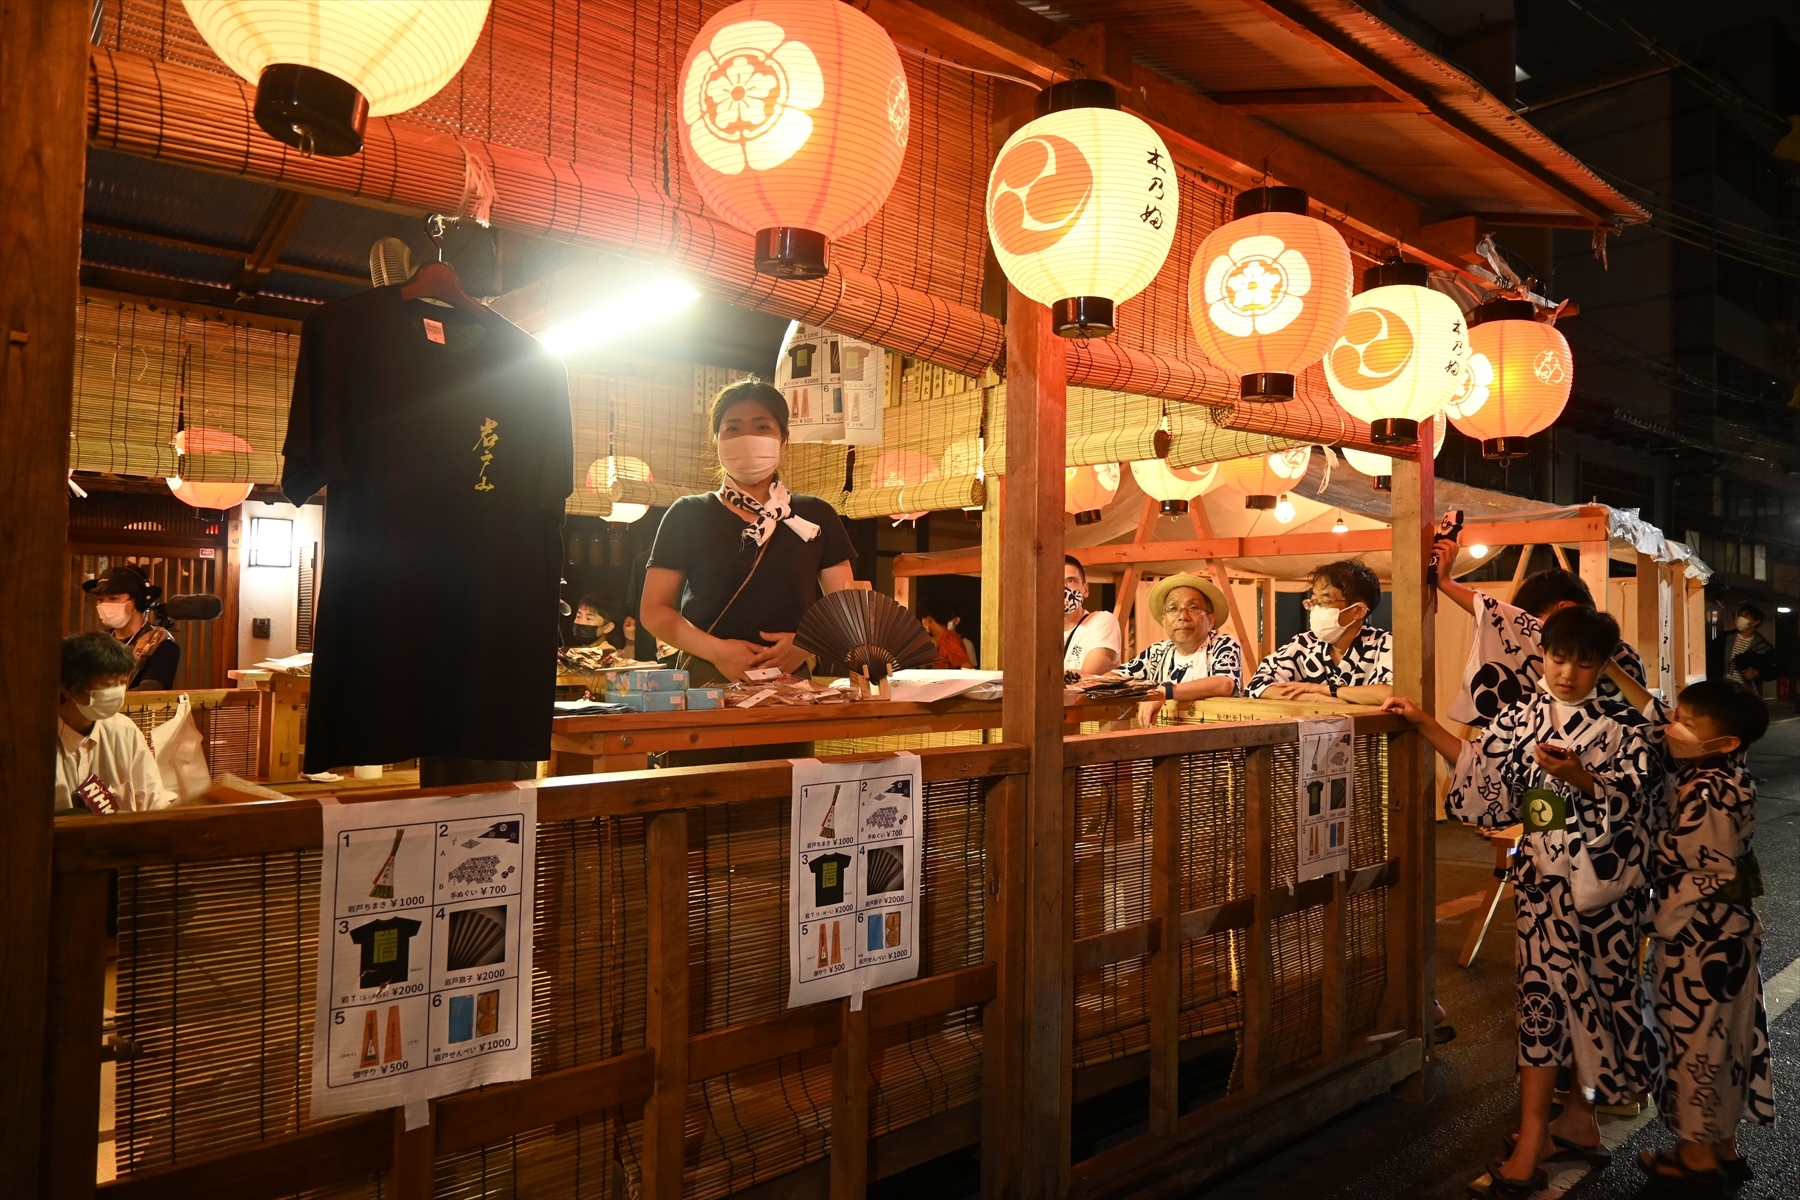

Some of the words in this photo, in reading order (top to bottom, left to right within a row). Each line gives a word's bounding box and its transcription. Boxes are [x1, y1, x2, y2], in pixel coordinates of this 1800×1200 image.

[804, 788, 808, 798] 1
[861, 782, 867, 792] 2
[439, 824, 449, 837] 2
[343, 835, 350, 847] 1
[833, 837, 854, 846] ¥1000
[860, 846, 865, 856] 4
[802, 855, 808, 865] 3
[450, 889, 478, 899] 手ぬぐい
[481, 884, 507, 895] ¥700
[348, 902, 387, 913] 岩戸ちまき
[390, 896, 425, 908] ¥1000
[884, 895, 905, 904] ¥2000
[436, 908, 446, 920] 4
[834, 904, 854, 914] ¥2000
[858, 913, 864, 923] 6
[339, 921, 349, 934] 3
[802, 925, 808, 935] 5
[888, 948, 908, 959] ¥1000
[829, 963, 845, 973] ¥500
[477, 969, 505, 982] ¥2000
[392, 983, 424, 996] ¥2000
[432, 994, 442, 1007] 6
[335, 1011, 345, 1024] 5
[434, 1047, 477, 1061] 岩戸せんべい
[479, 1038, 511, 1051] ¥1000
[381, 1060, 409, 1074] ¥500
